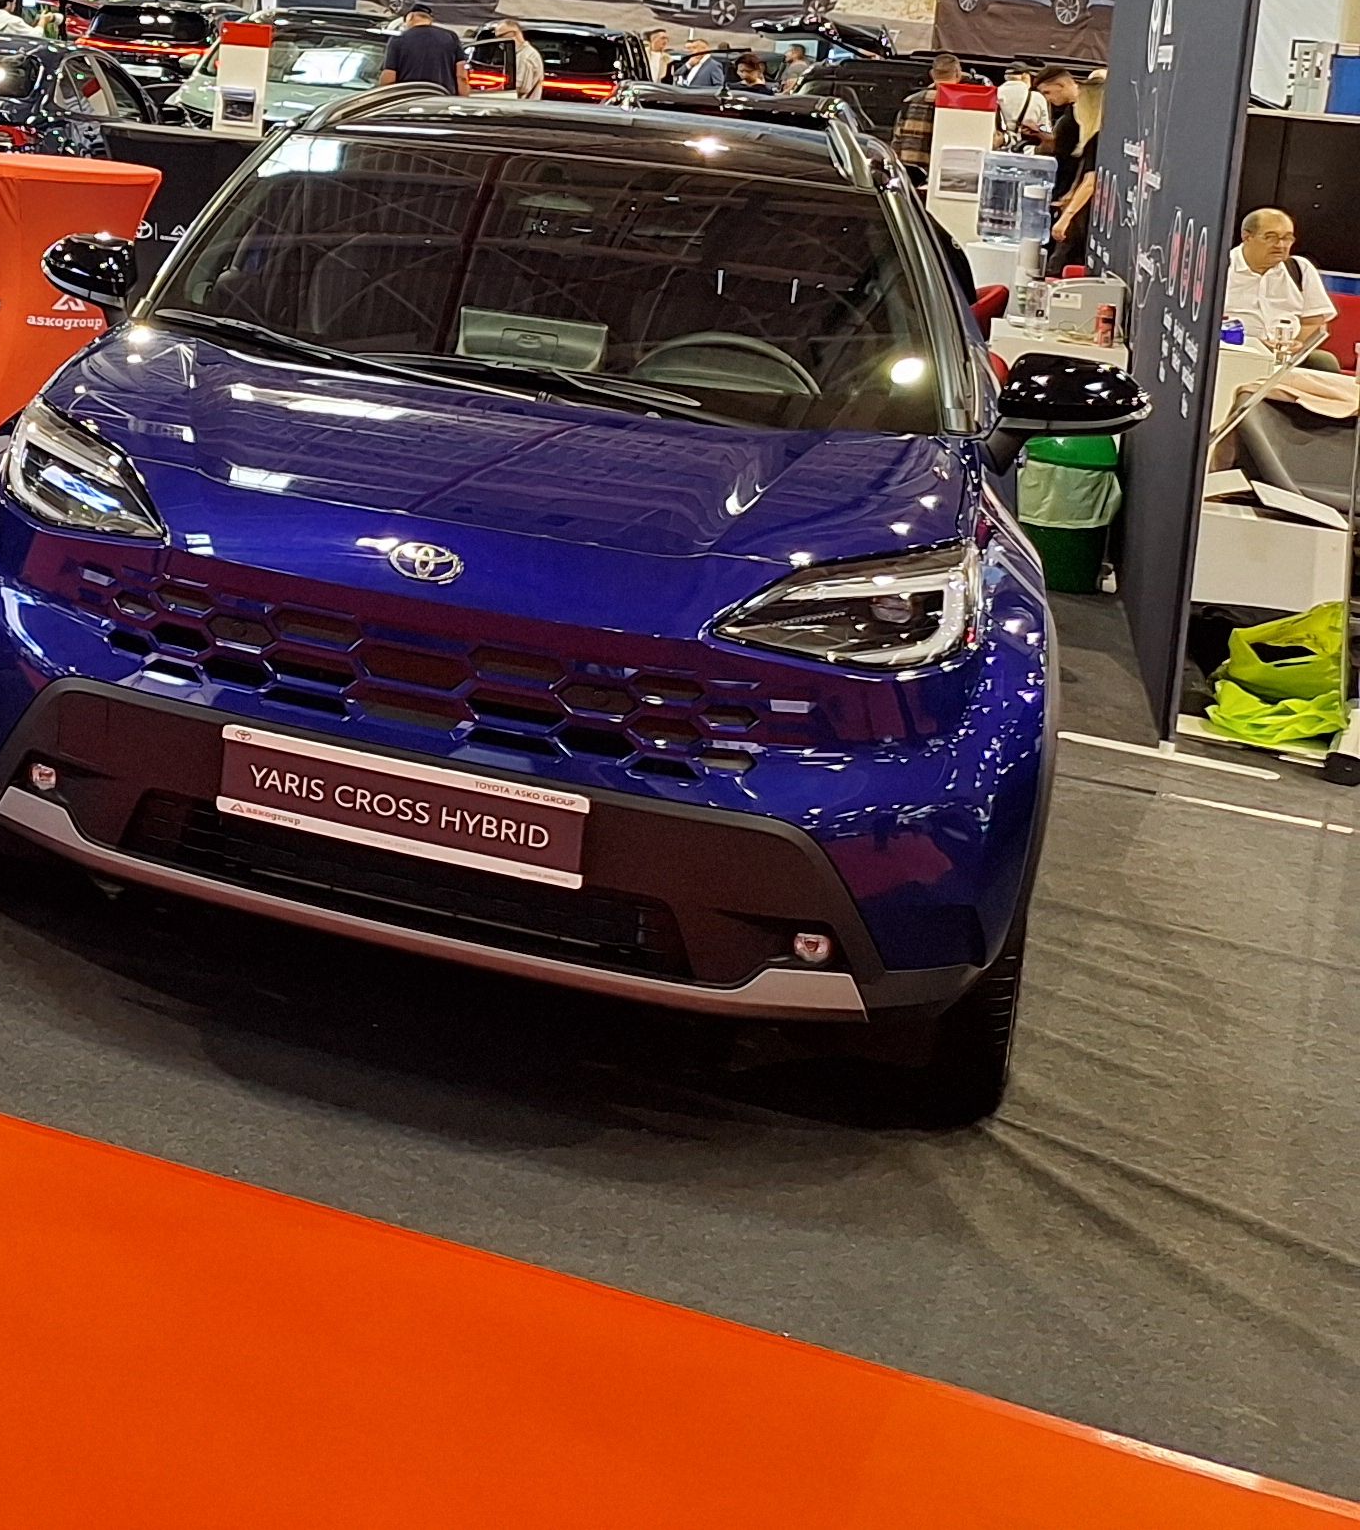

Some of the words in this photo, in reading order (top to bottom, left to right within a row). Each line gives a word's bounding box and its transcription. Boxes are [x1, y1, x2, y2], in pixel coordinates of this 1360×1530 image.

[27, 314, 103, 331] askogroup
[475, 781, 510, 795] TOYOTA
[514, 790, 540, 800] ASKO
[543, 795, 577, 807] GROUP
[246, 807, 301, 826] askogroup
[250, 765, 325, 802] YARIS
[334, 785, 430, 825] CROSS
[440, 807, 550, 849] HYBRID
